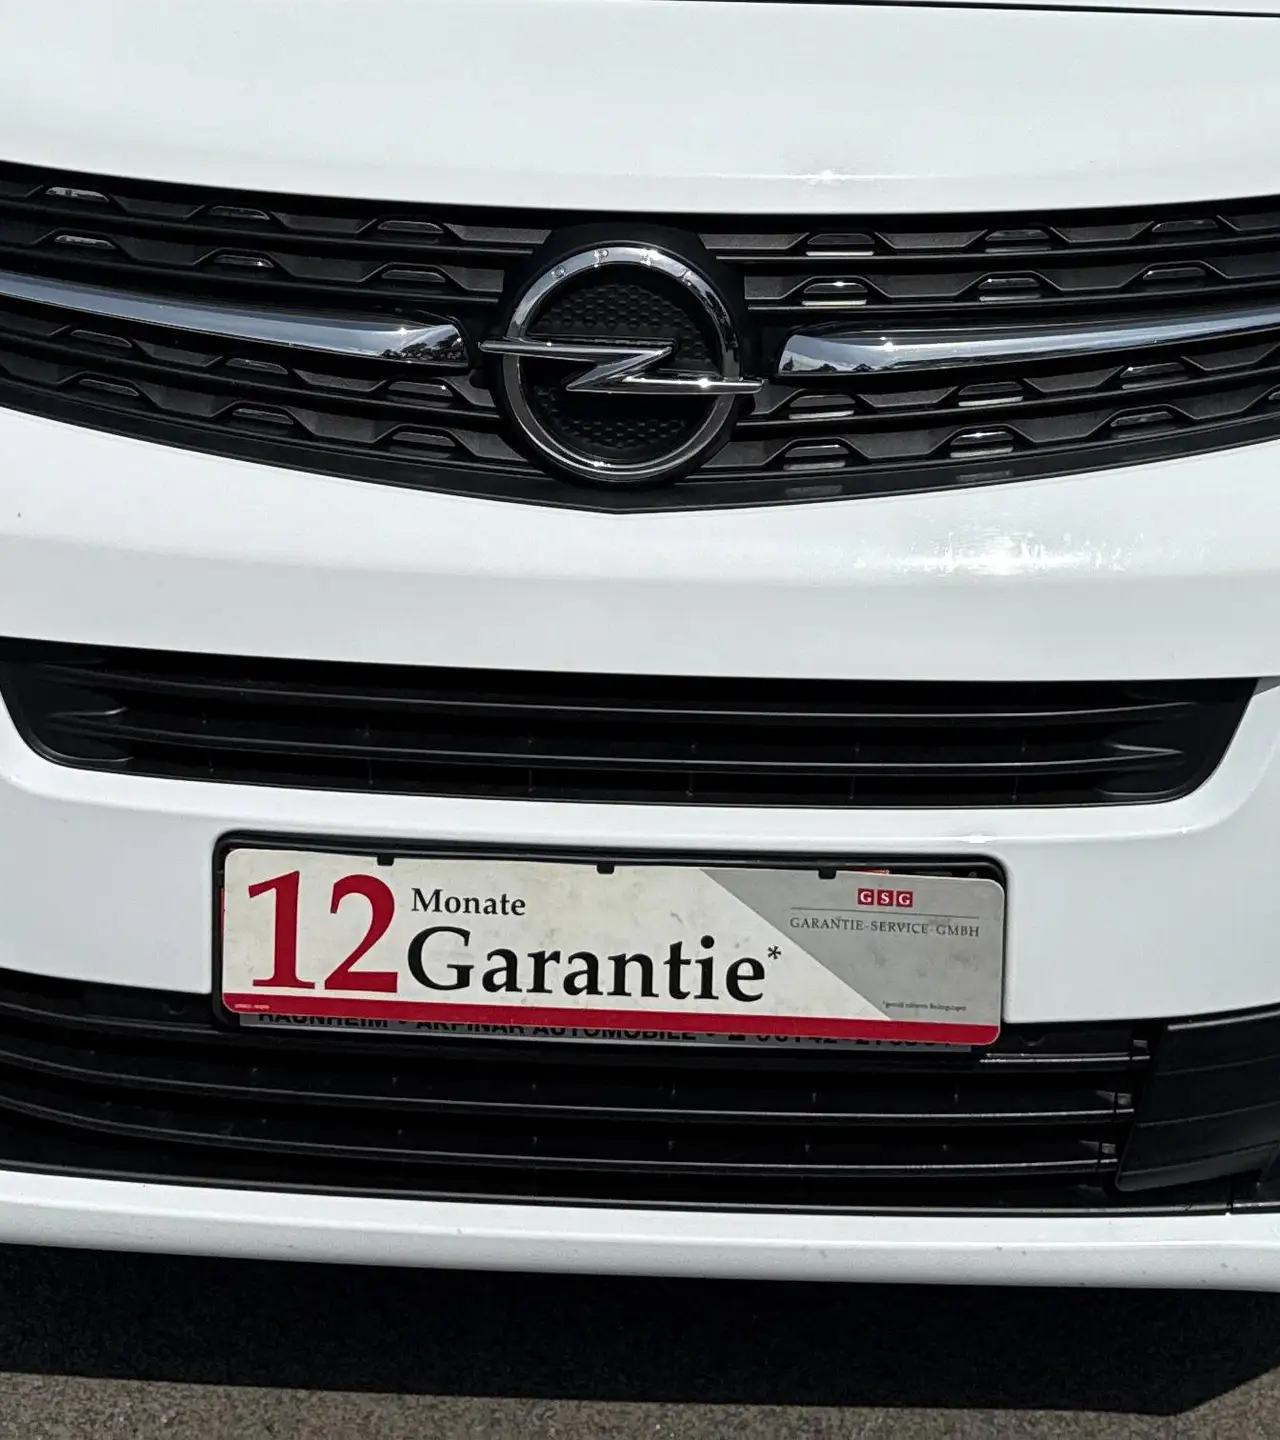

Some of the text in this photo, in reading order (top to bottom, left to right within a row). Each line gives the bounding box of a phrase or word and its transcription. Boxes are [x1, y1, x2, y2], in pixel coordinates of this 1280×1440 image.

[247, 869, 526, 994] 12 Monate
[859, 889, 913, 907] GSG
